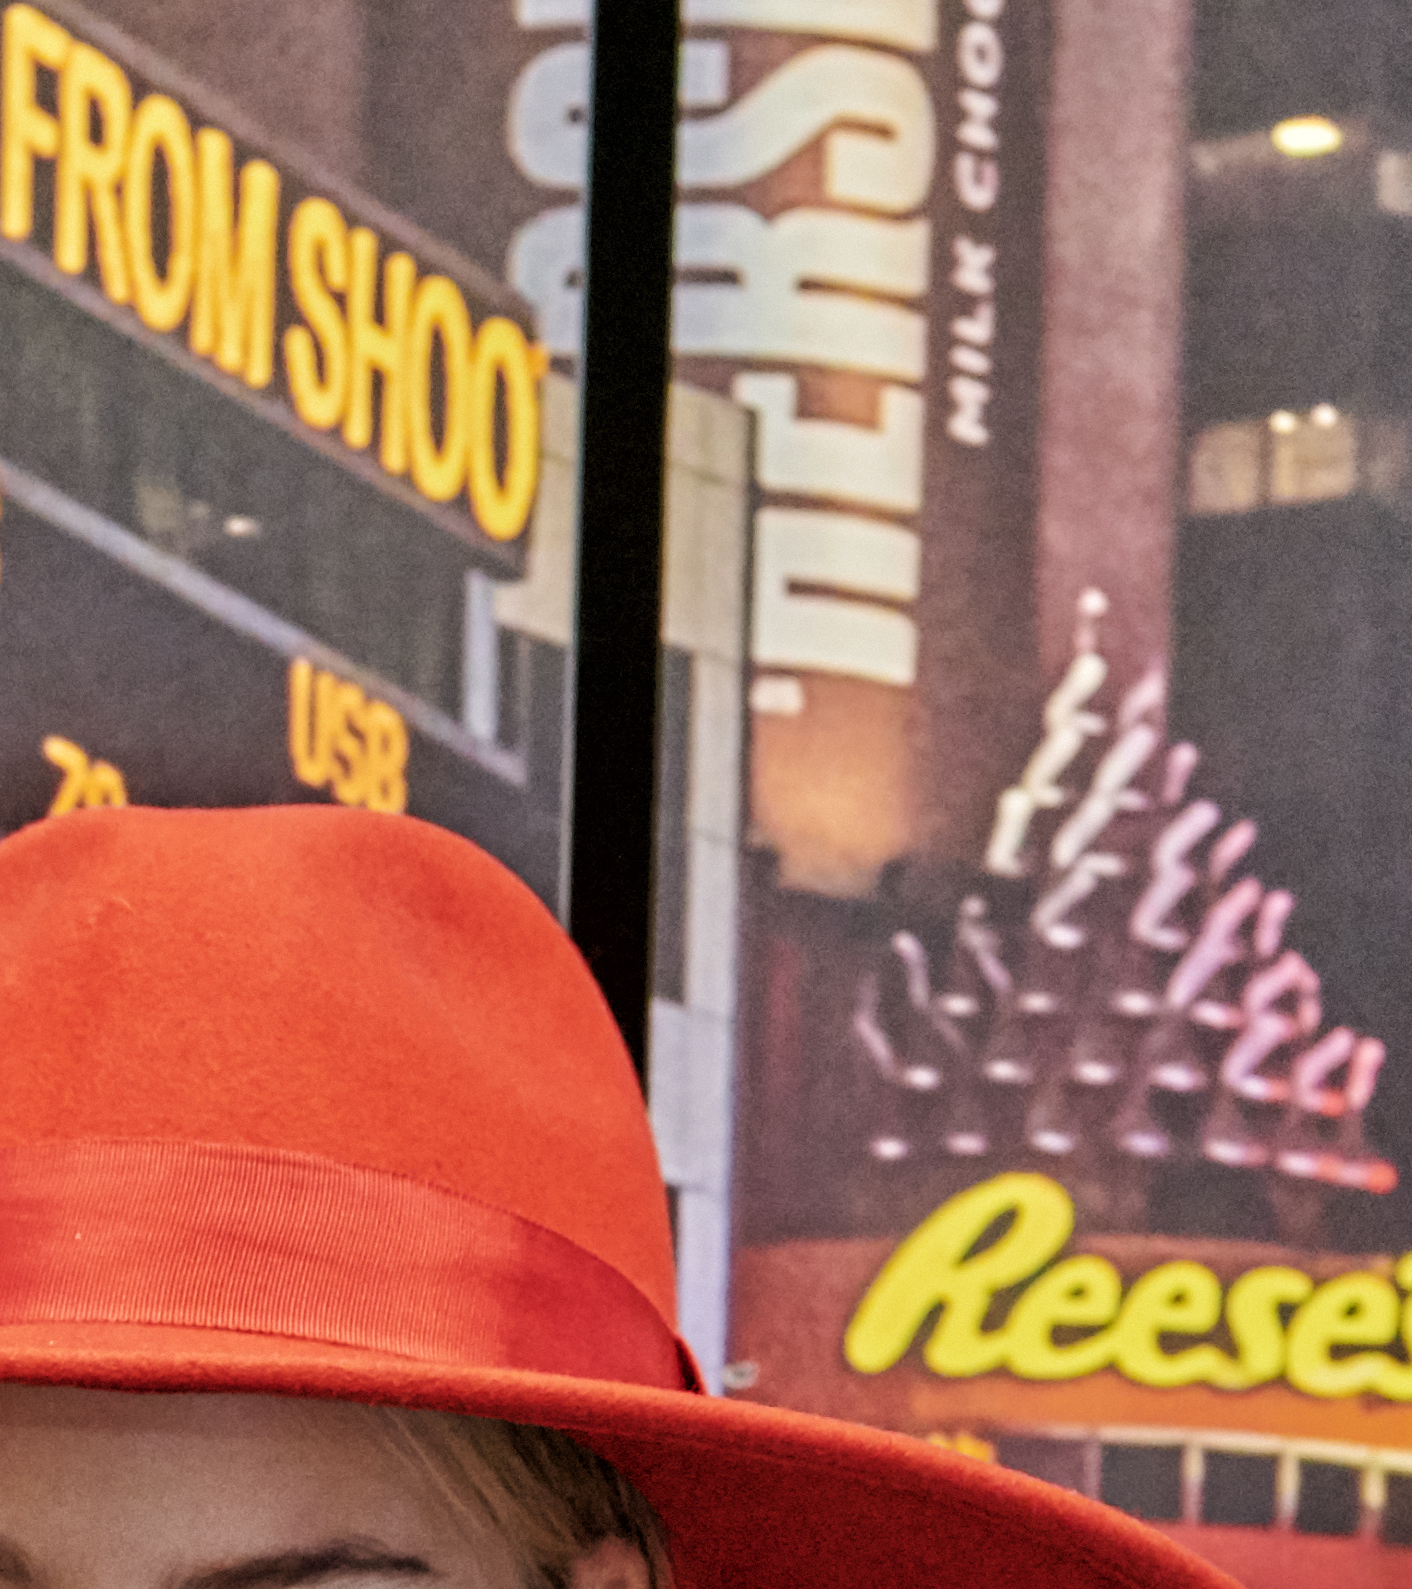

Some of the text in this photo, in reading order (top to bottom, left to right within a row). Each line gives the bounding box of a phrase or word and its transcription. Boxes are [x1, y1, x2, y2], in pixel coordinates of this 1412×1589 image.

[946, 231, 999, 449] MILK
[287, 659, 410, 815] USB
[843, 1169, 1412, 1405] Reese
